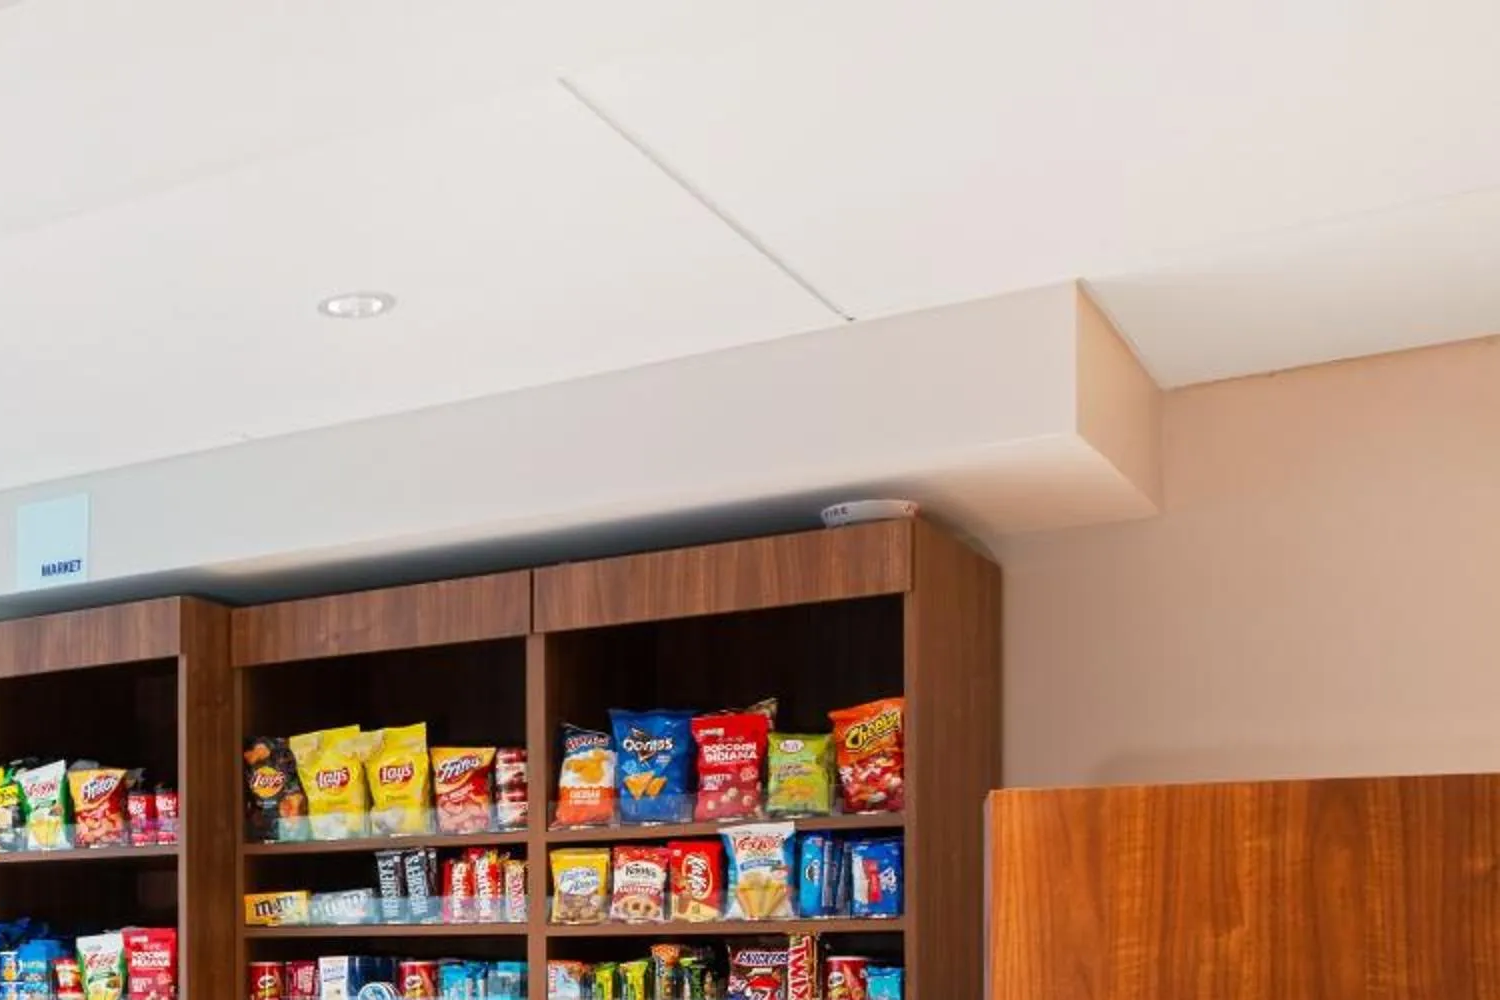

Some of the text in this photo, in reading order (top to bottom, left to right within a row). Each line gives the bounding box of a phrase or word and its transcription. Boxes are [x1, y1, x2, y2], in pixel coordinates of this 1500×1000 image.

[41, 559, 81, 576] MARKET
[703, 742, 757, 753] POPCORN
[706, 752, 758, 763] INDIANA
